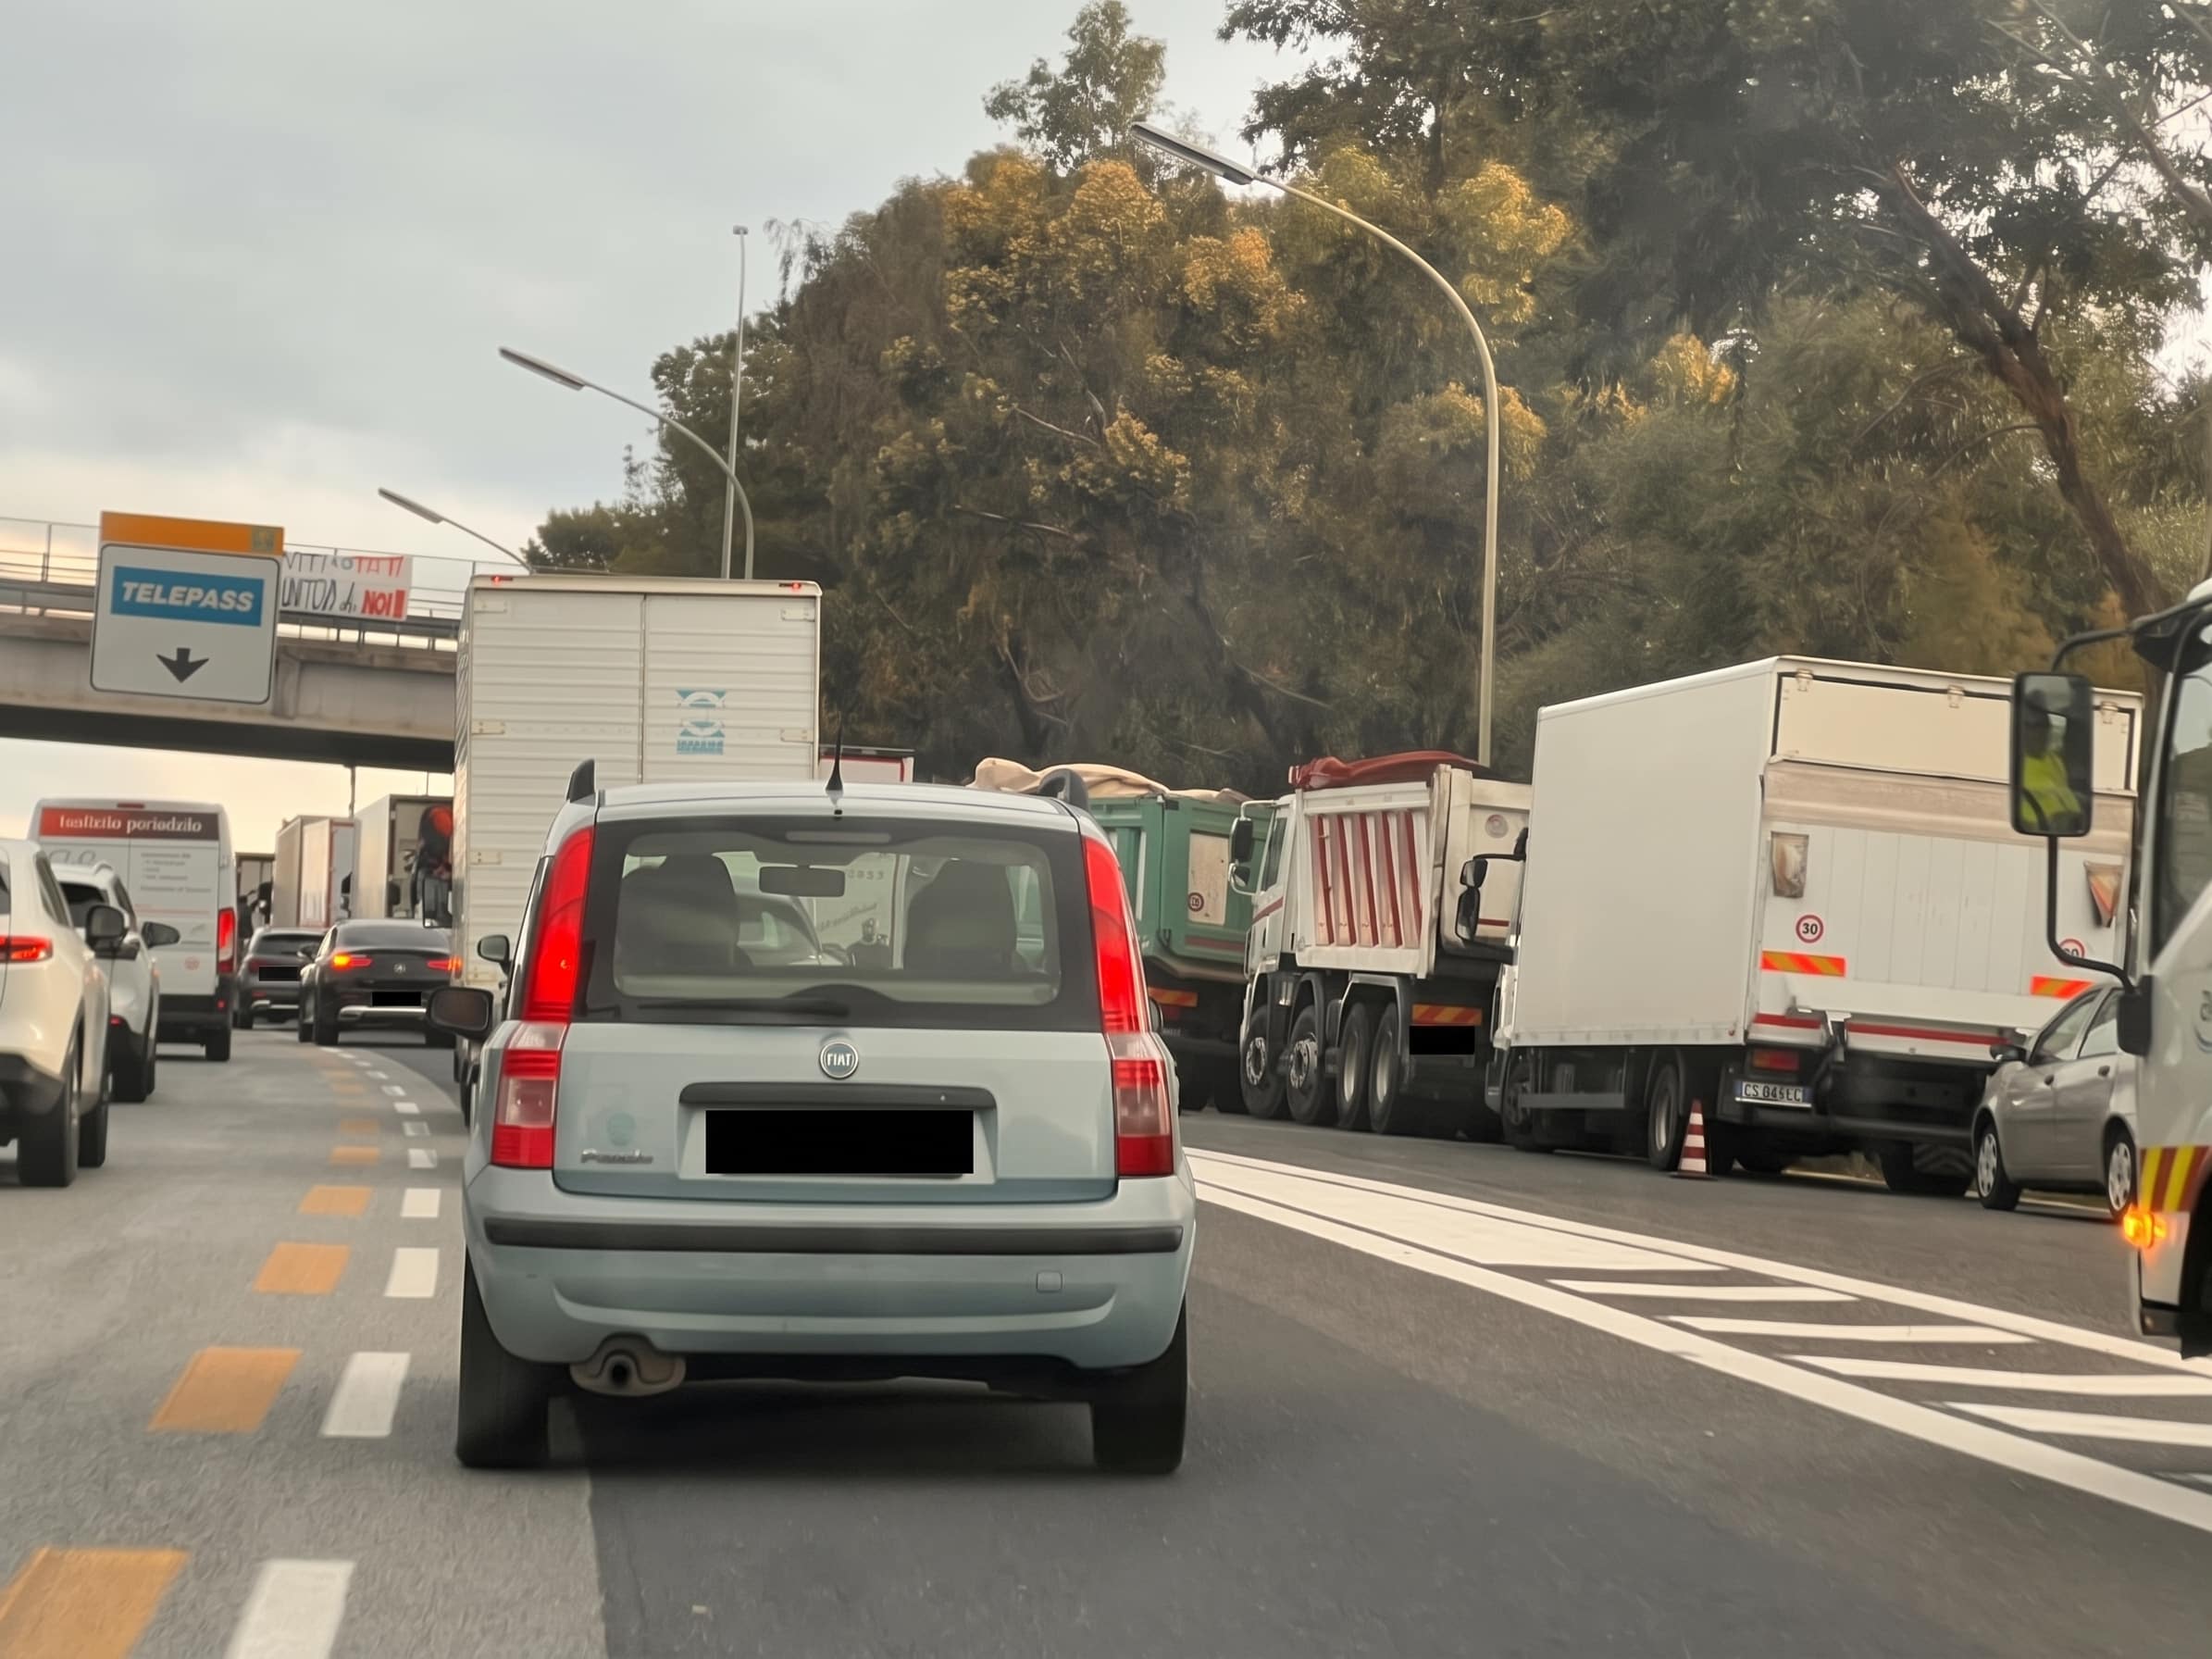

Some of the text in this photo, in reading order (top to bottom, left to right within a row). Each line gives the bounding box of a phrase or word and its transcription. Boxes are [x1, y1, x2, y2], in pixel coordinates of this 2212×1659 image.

[122, 580, 255, 613] TELEPASS
[1802, 922, 1819, 935] 30
[826, 1053, 852, 1066] FIAT
